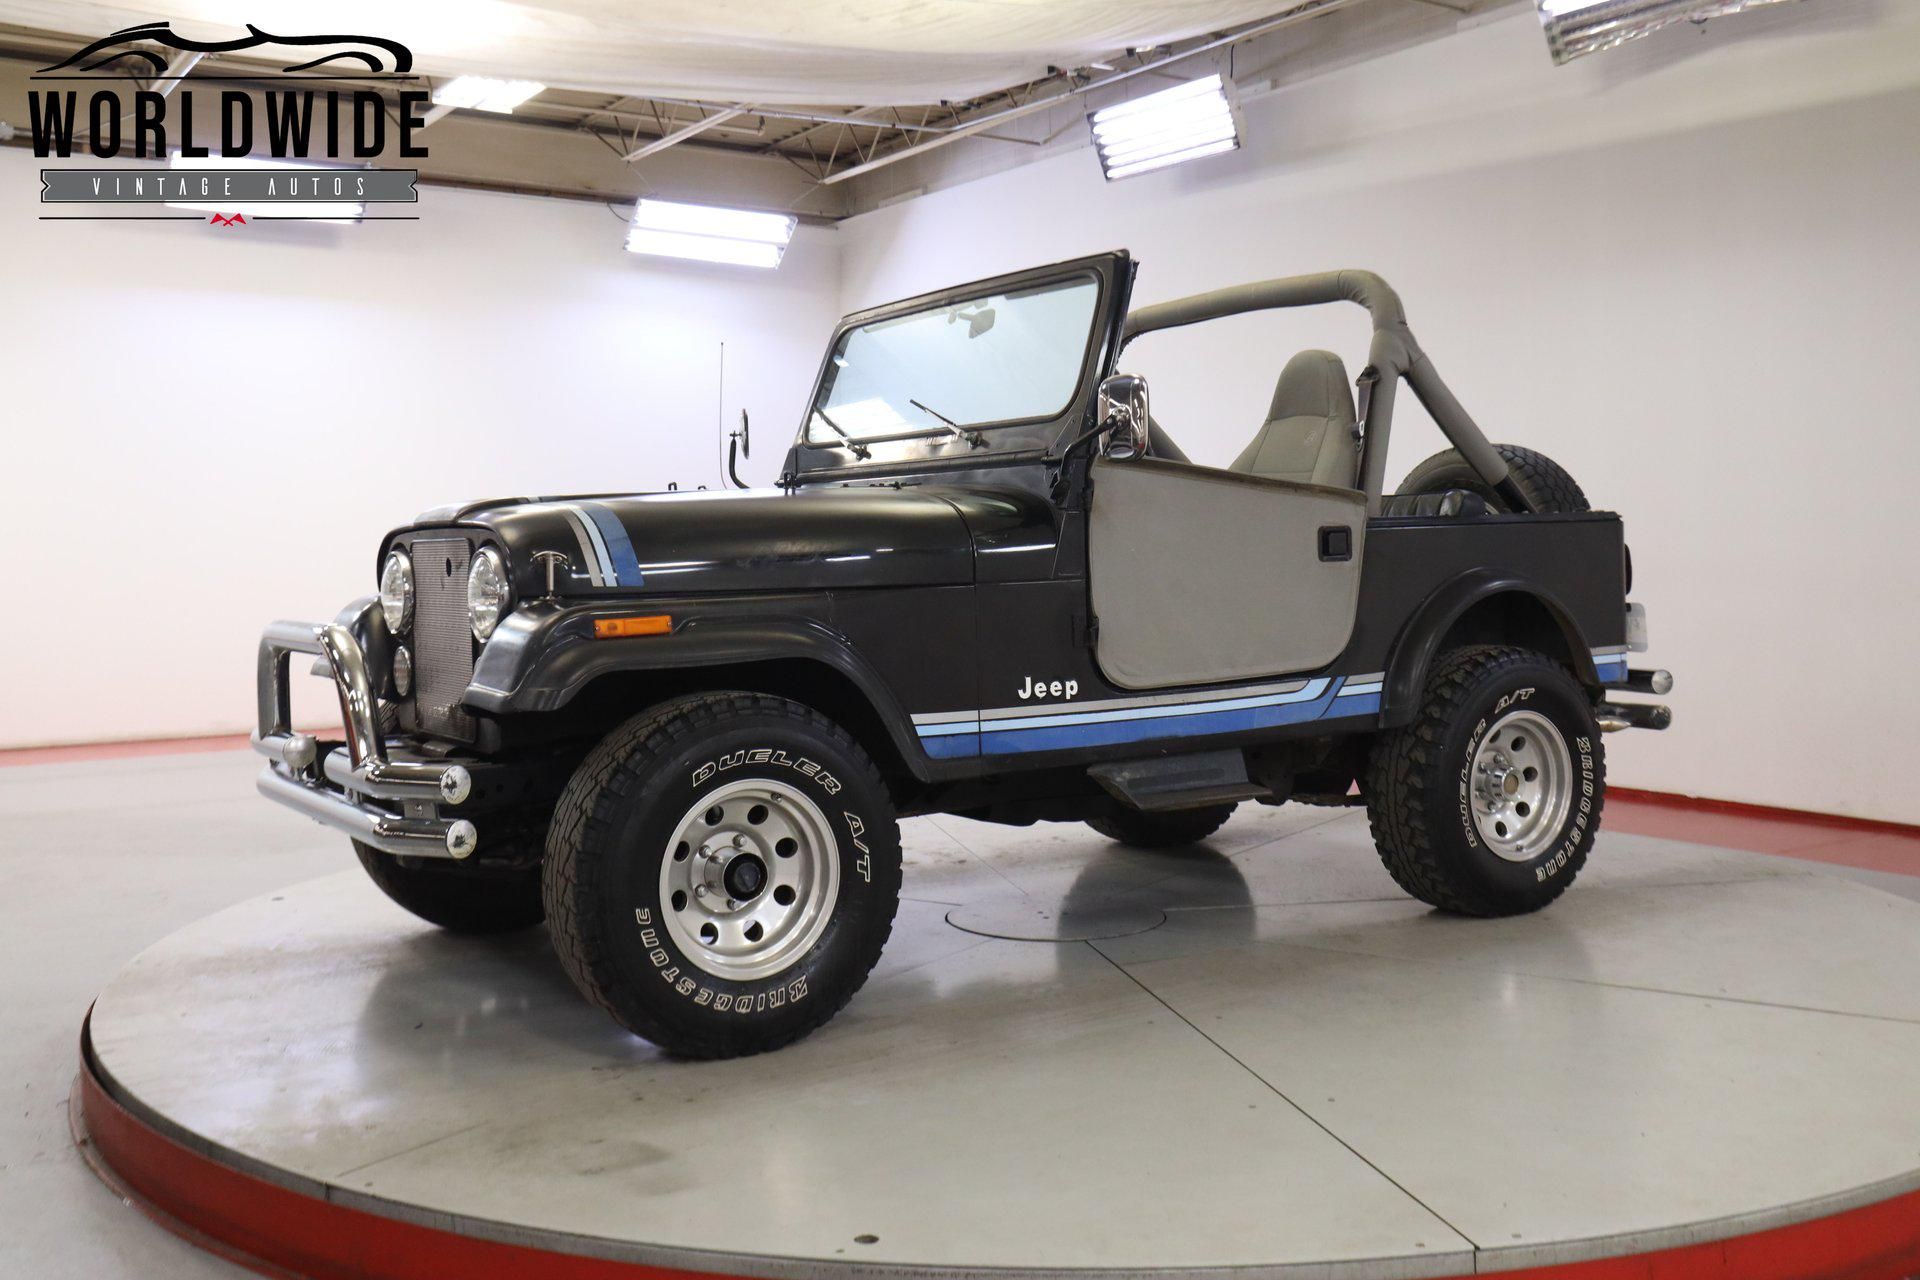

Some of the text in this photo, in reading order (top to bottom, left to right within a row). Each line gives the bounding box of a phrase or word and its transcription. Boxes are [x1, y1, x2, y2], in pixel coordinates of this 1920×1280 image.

[1017, 676, 1079, 700] Jeep
[691, 749, 871, 882] DUELER A/T
[1459, 687, 1536, 848] DUELER A/T
[1535, 737, 1594, 882] BRIDGESTONE
[635, 907, 809, 1014] BRIDGESTONE
